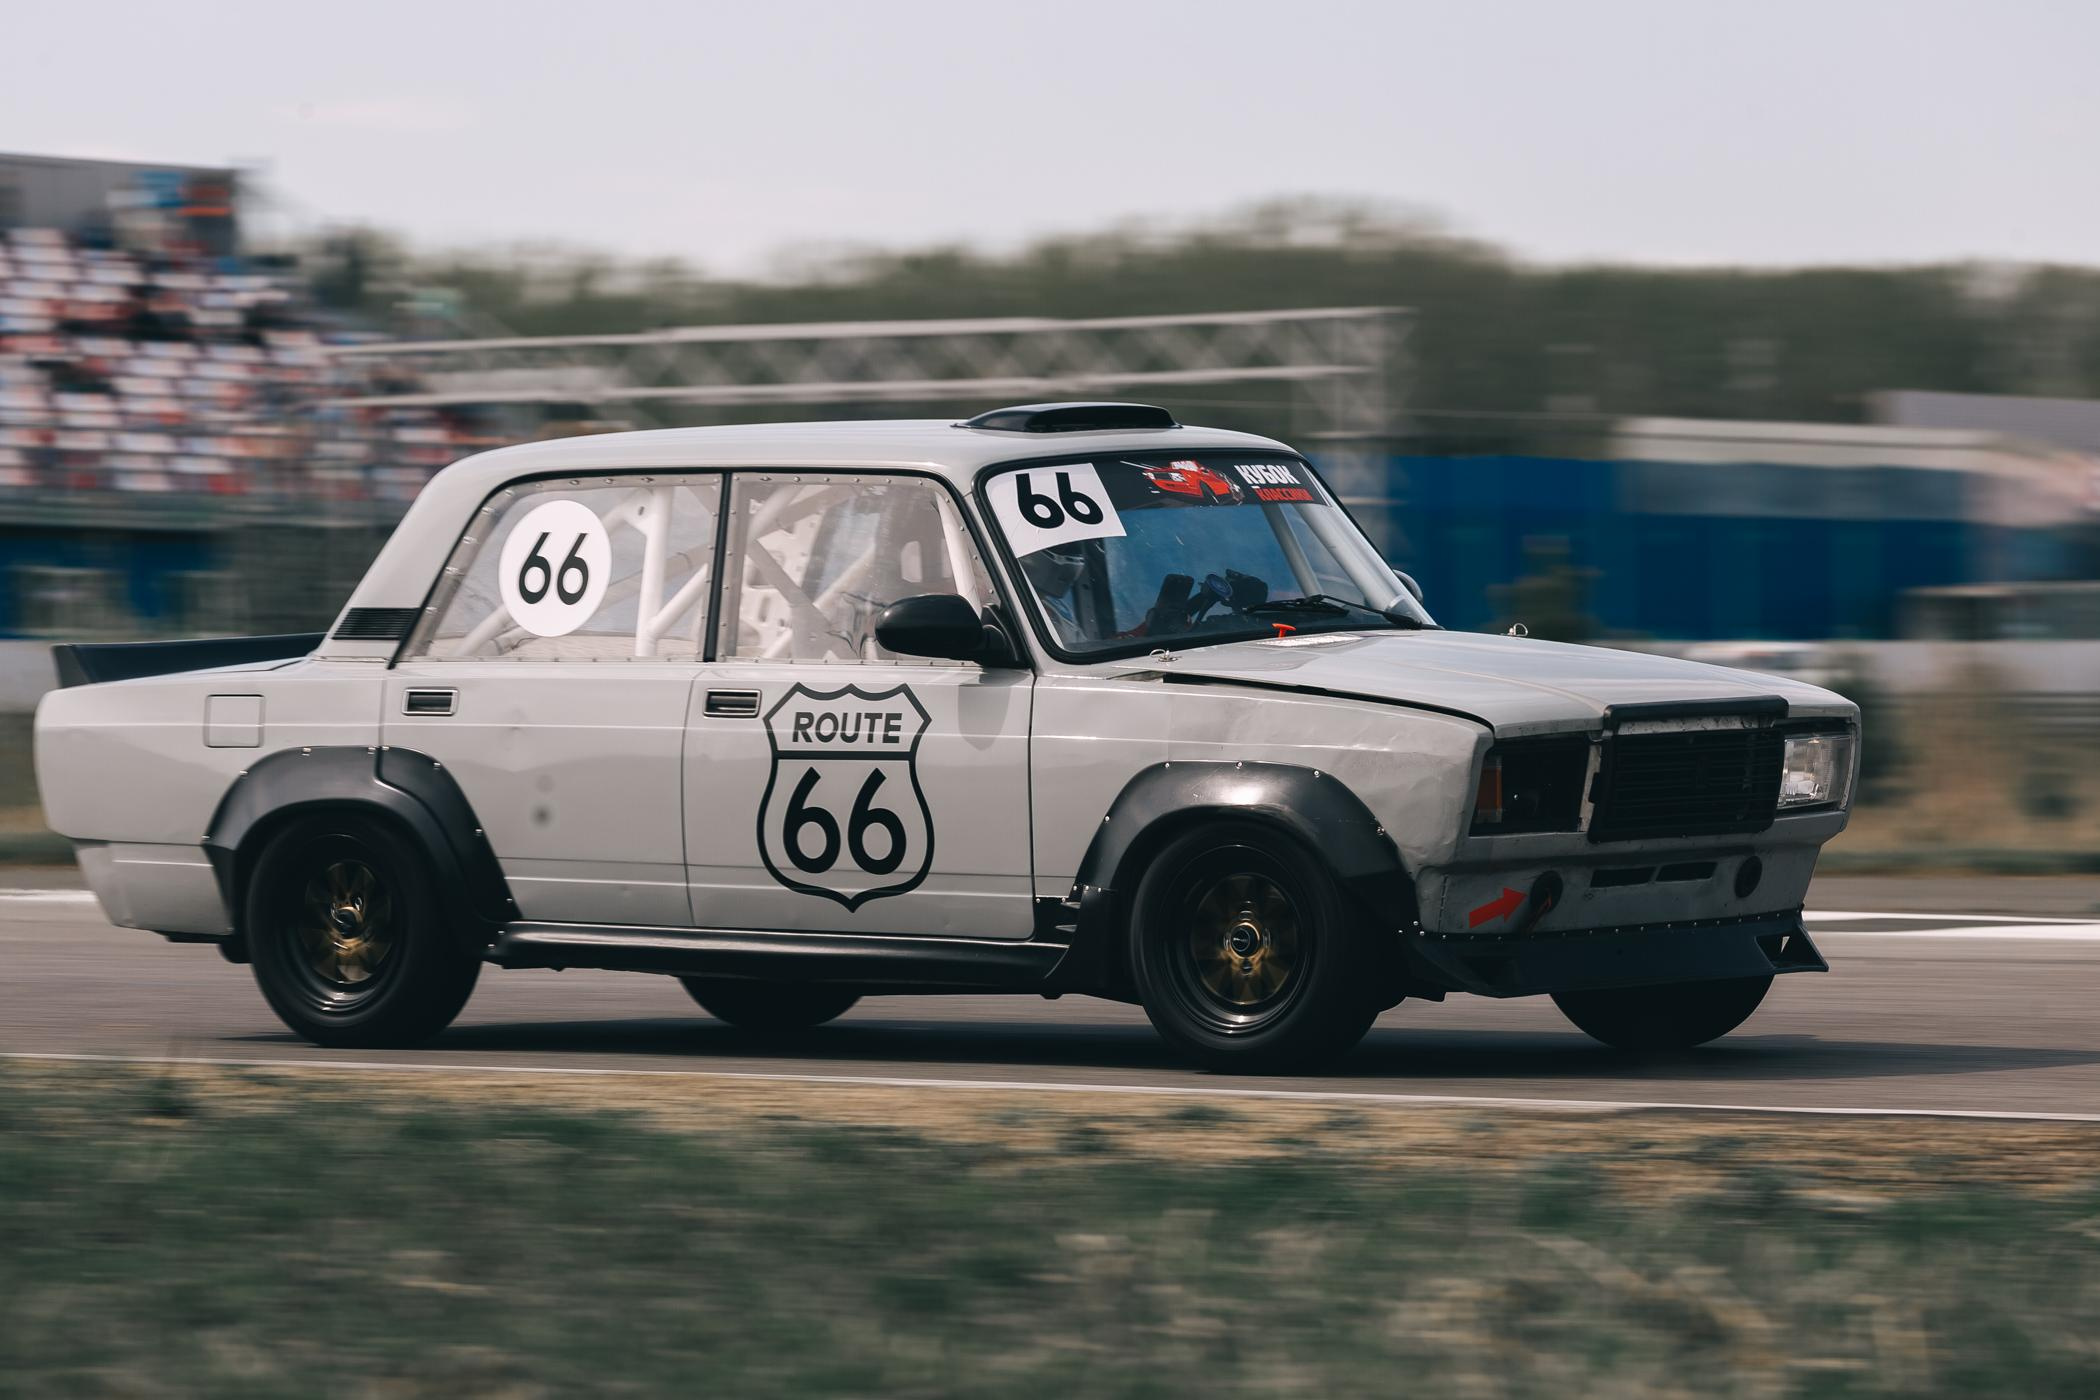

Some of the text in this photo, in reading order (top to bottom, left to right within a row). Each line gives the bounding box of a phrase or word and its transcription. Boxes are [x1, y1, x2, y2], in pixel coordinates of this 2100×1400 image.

[1015, 471, 1104, 530] 66
[1234, 464, 1301, 485] КУБОК
[518, 531, 589, 606] 66
[791, 711, 903, 744] ROUTE
[782, 766, 907, 876] 66
